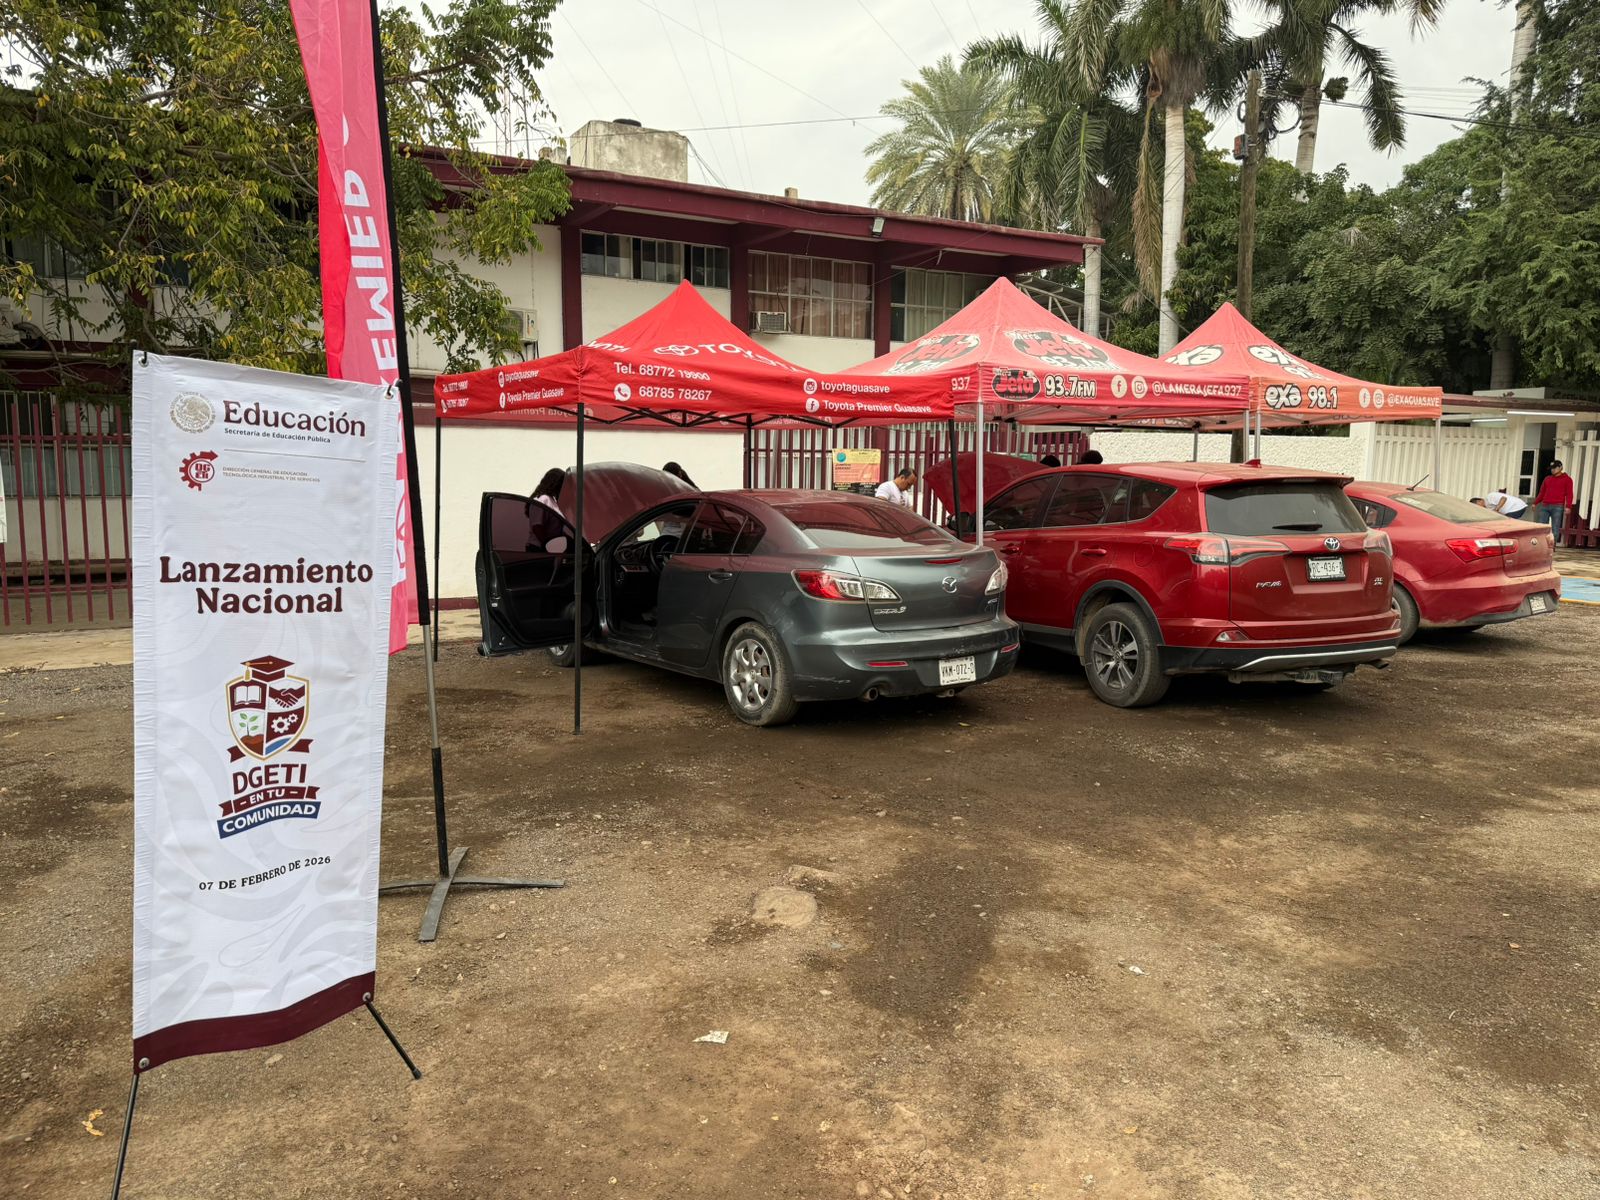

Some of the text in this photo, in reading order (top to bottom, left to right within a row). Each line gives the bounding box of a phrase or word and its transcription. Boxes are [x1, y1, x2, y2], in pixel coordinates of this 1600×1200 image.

[614, 362, 636, 375] Tel.
[638, 363, 675, 378] 68772
[638, 385, 713, 401] 68785 78267
[821, 380, 891, 395] toyotaguasave
[951, 376, 970, 391] 937
[1045, 375, 1097, 398] 93.7FM
[1152, 380, 1243, 397] @LAMERAJEFA937
[824, 399, 932, 414] Toyota Premier Guasave
[1264, 383, 1339, 410] exa 98.1
[223, 400, 366, 437] Educación
[224, 428, 260, 437] Secretaría
[272, 432, 306, 441] Educación
[307, 435, 331, 444] Pública
[159, 556, 374, 584] Lanzamiento
[196, 587, 343, 614] Nacional
[232, 763, 308, 795] DGETI
[250, 788, 285, 804] EN TU
[222, 803, 316, 833] COMUNIDAD
[198, 856, 331, 891] 07 DE FEBRERO DE 2026
